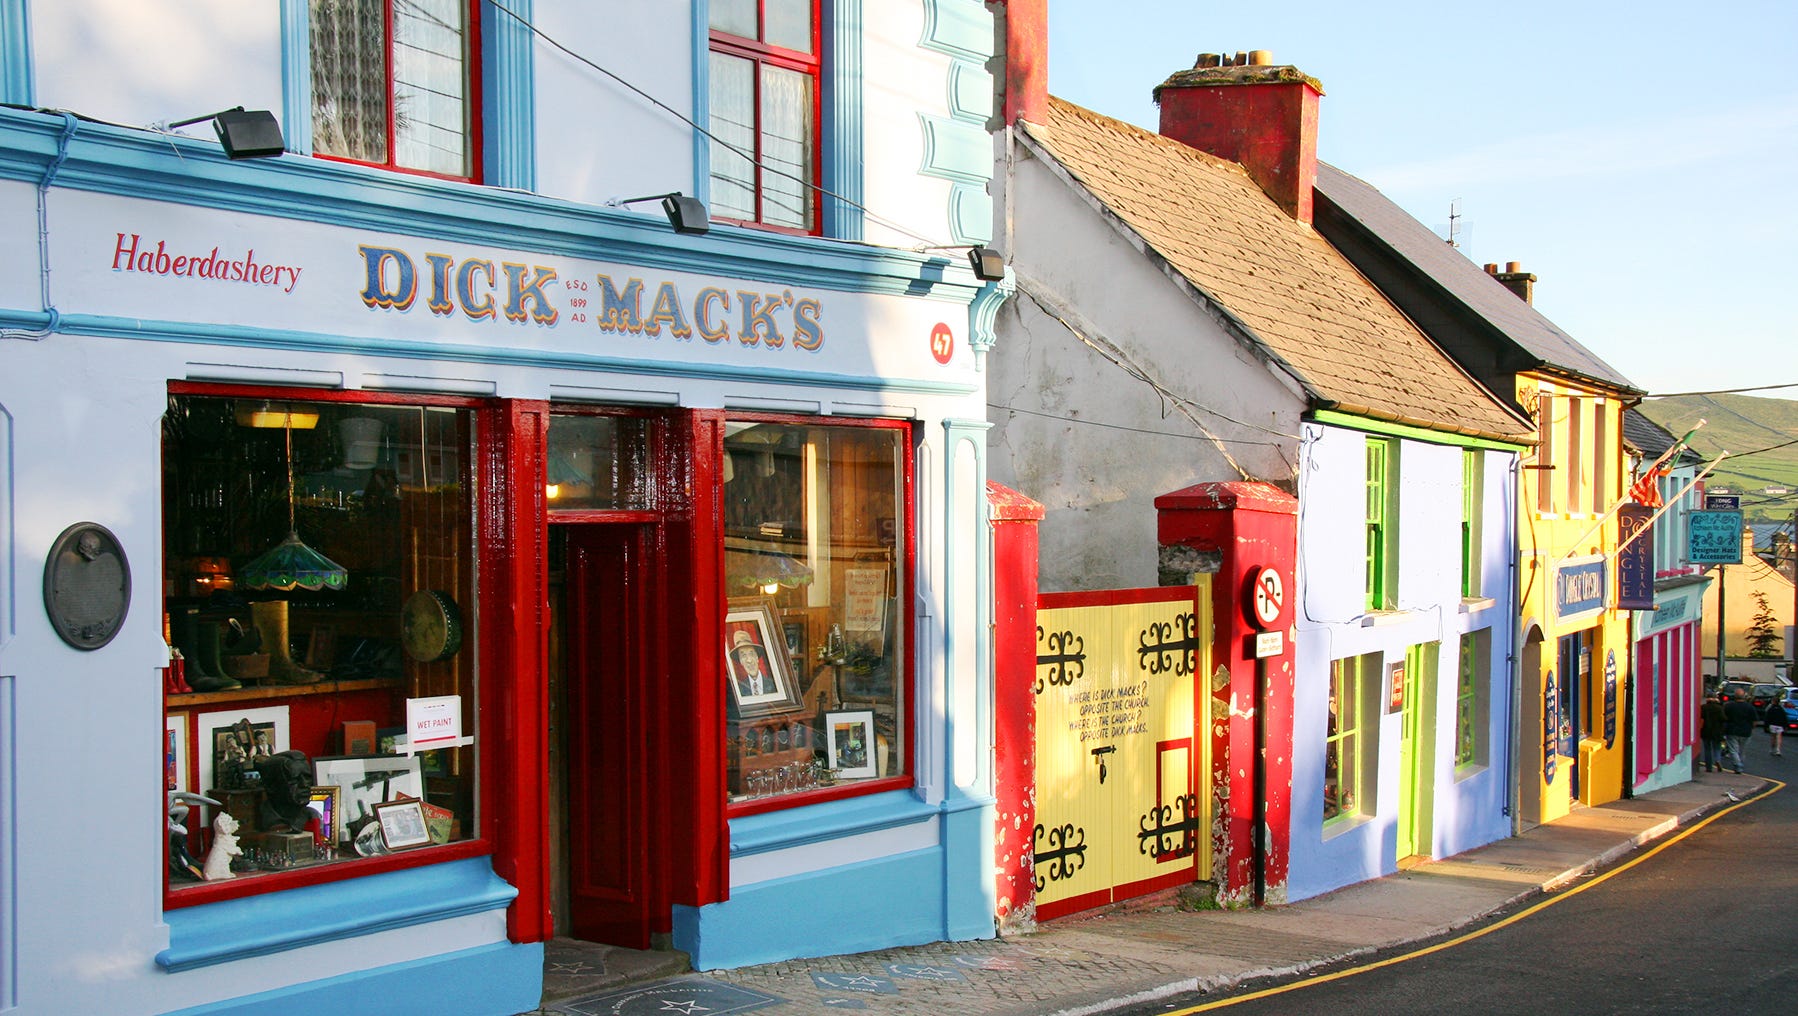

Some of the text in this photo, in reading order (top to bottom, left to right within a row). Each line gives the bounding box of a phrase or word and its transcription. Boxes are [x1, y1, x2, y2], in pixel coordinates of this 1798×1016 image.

[111, 233, 303, 293] Haberdashery
[565, 280, 588, 291] ESD
[358, 244, 824, 351] DICK MACK'S
[570, 298, 587, 308] 1899
[571, 313, 586, 323] AD
[933, 333, 951, 356] 47
[1692, 547, 1719, 555] Designer
[1092, 690, 1099, 701] IS
[1100, 689, 1114, 701] DICK
[1080, 702, 1109, 716] OPPOSITE
[1112, 700, 1123, 711] THE
[417, 717, 452, 729] WET PAINT
[1099, 715, 1109, 728] THE
[1080, 728, 1109, 742] OPPOSITE
[1111, 726, 1125, 738] DICK
